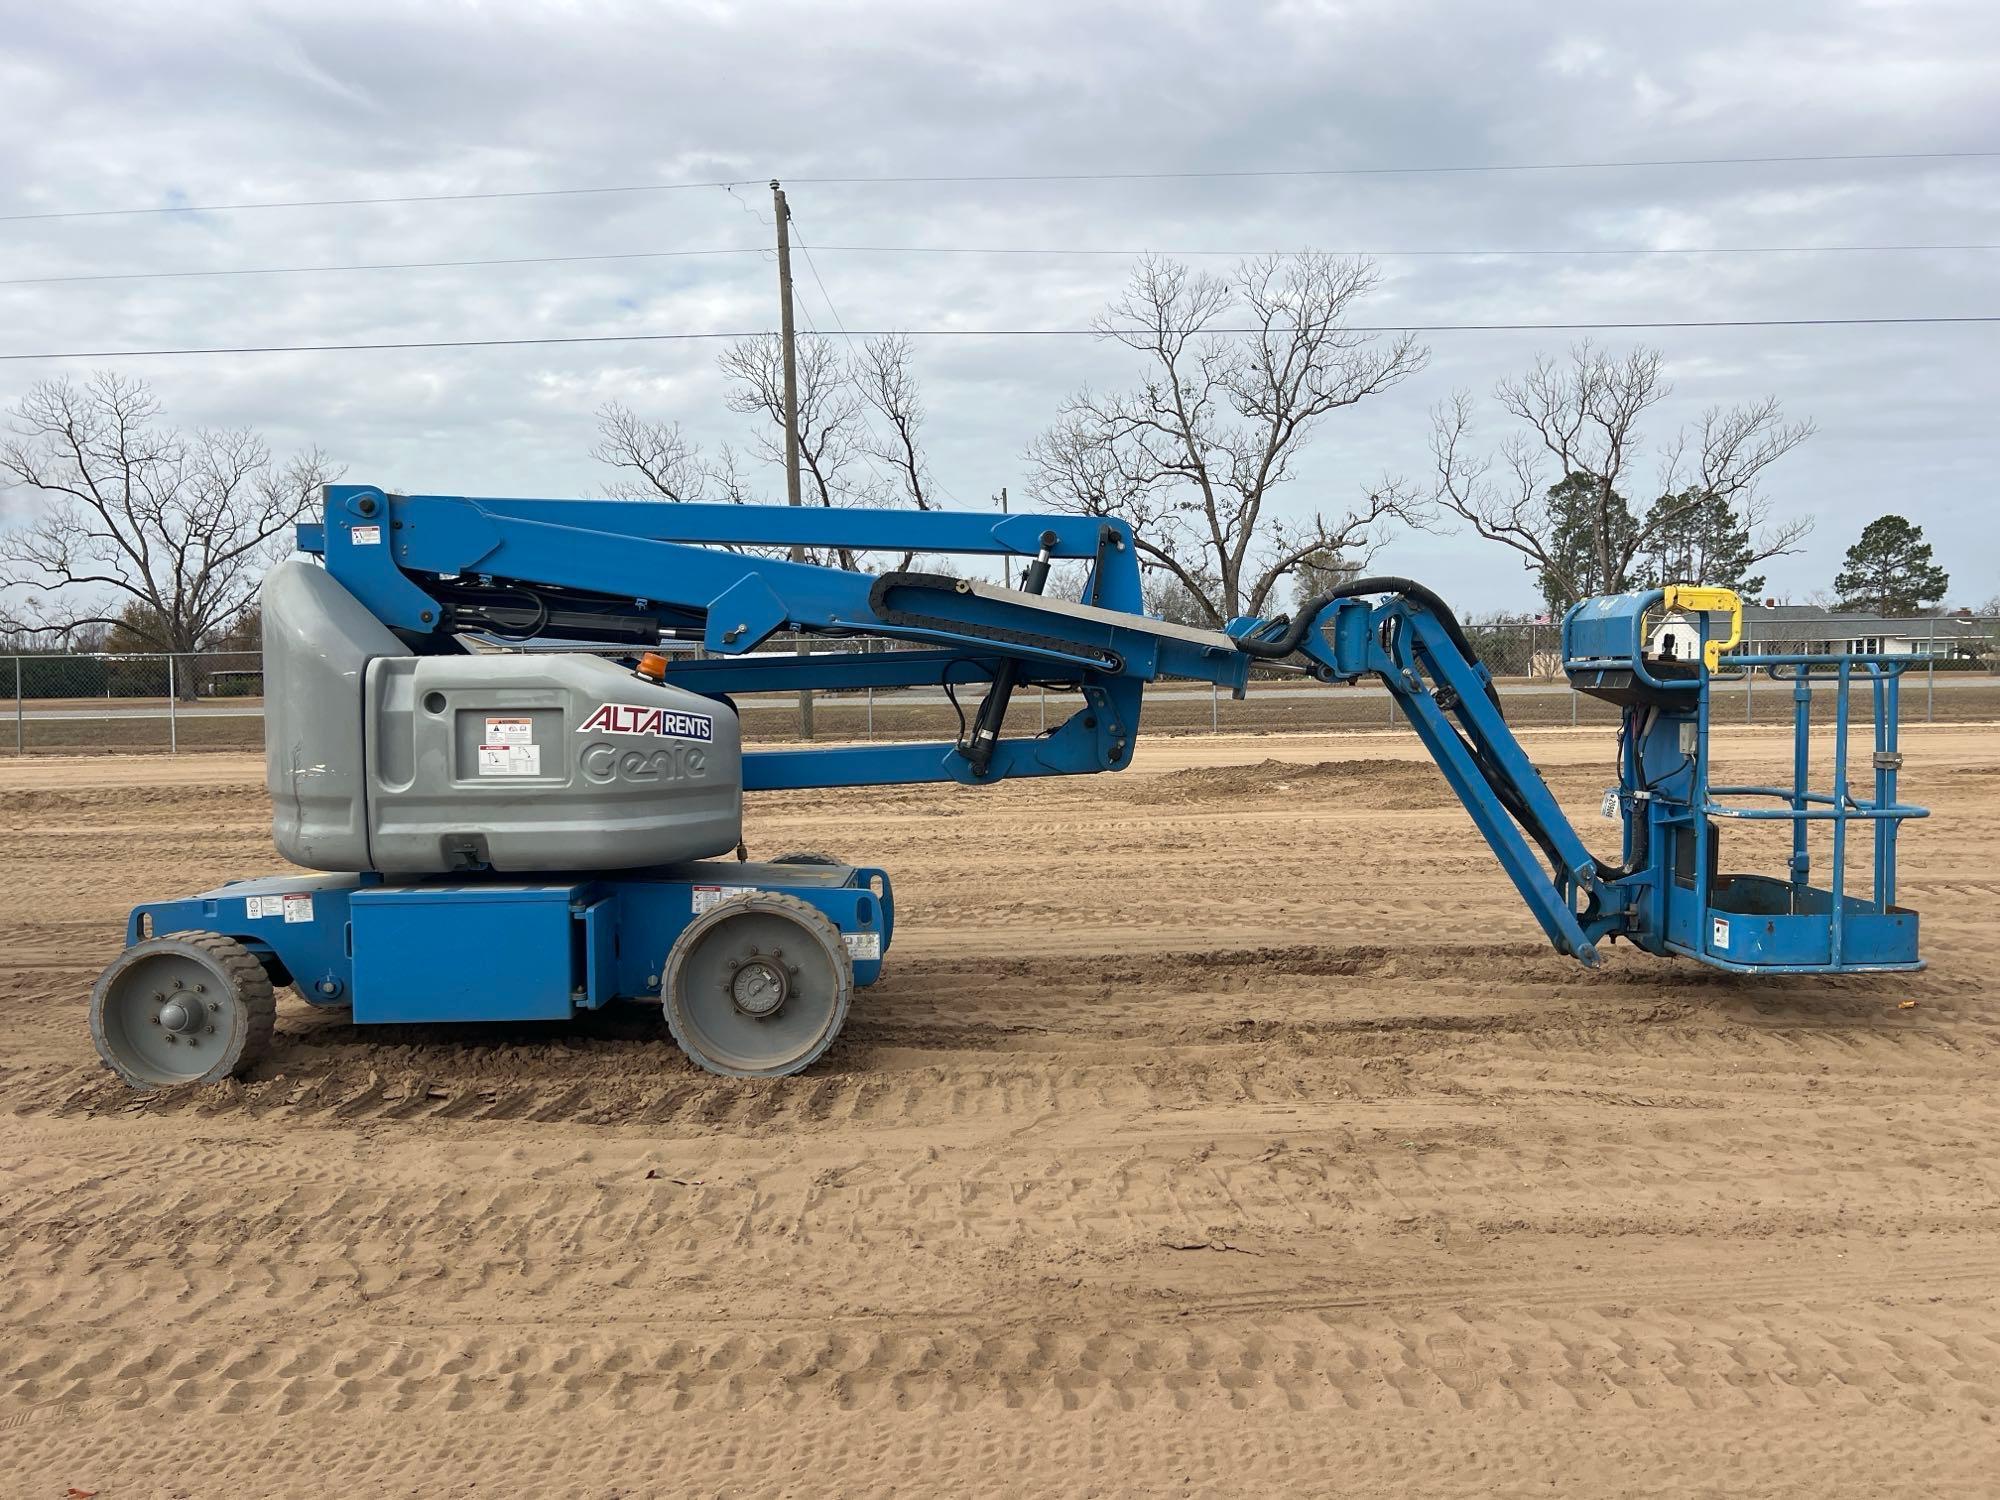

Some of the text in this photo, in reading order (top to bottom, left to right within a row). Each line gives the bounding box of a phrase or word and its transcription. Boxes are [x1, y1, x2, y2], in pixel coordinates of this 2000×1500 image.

[582, 706, 710, 738] ALTA RENTS
[580, 739, 706, 784] Genie
